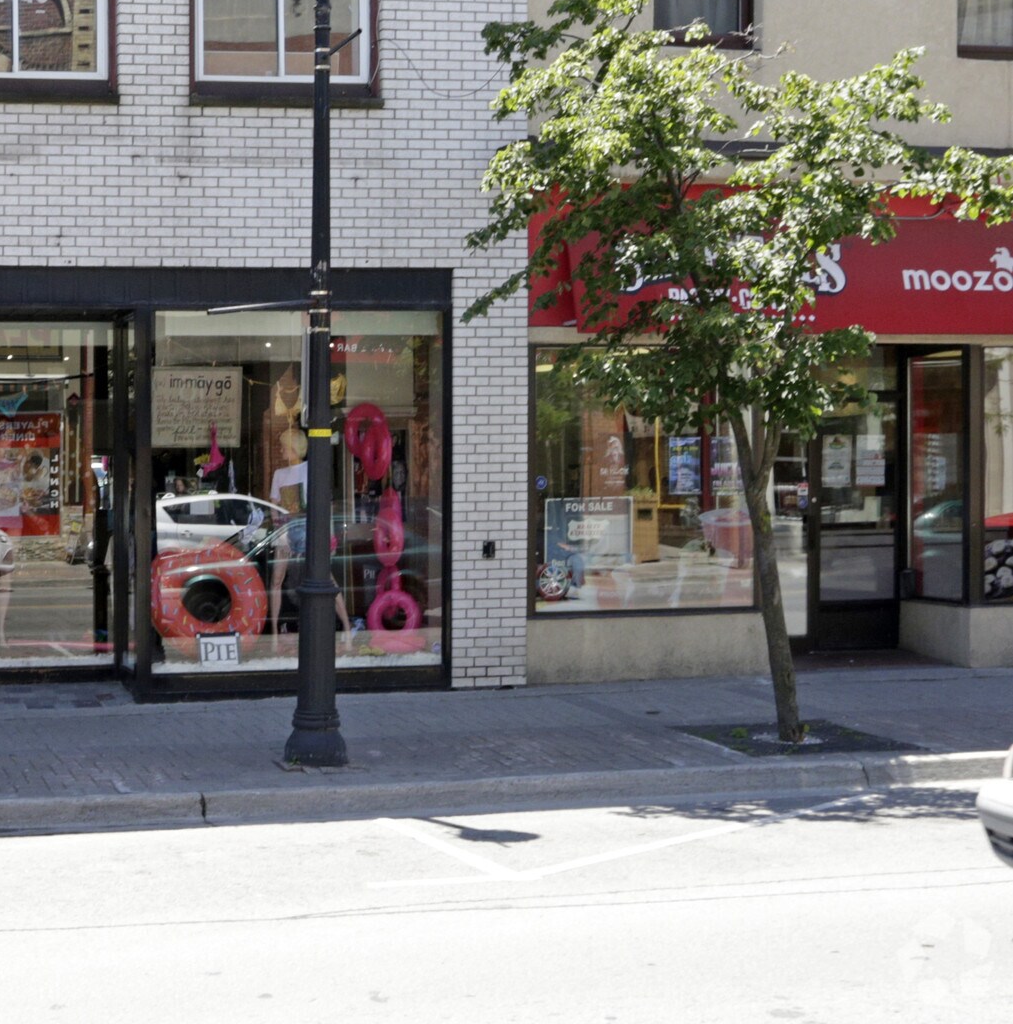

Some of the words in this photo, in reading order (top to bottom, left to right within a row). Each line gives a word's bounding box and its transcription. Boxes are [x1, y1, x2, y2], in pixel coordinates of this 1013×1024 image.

[565, 502, 586, 512] FOR
[588, 501, 613, 512] SALE
[202, 642, 236, 662] PIE
